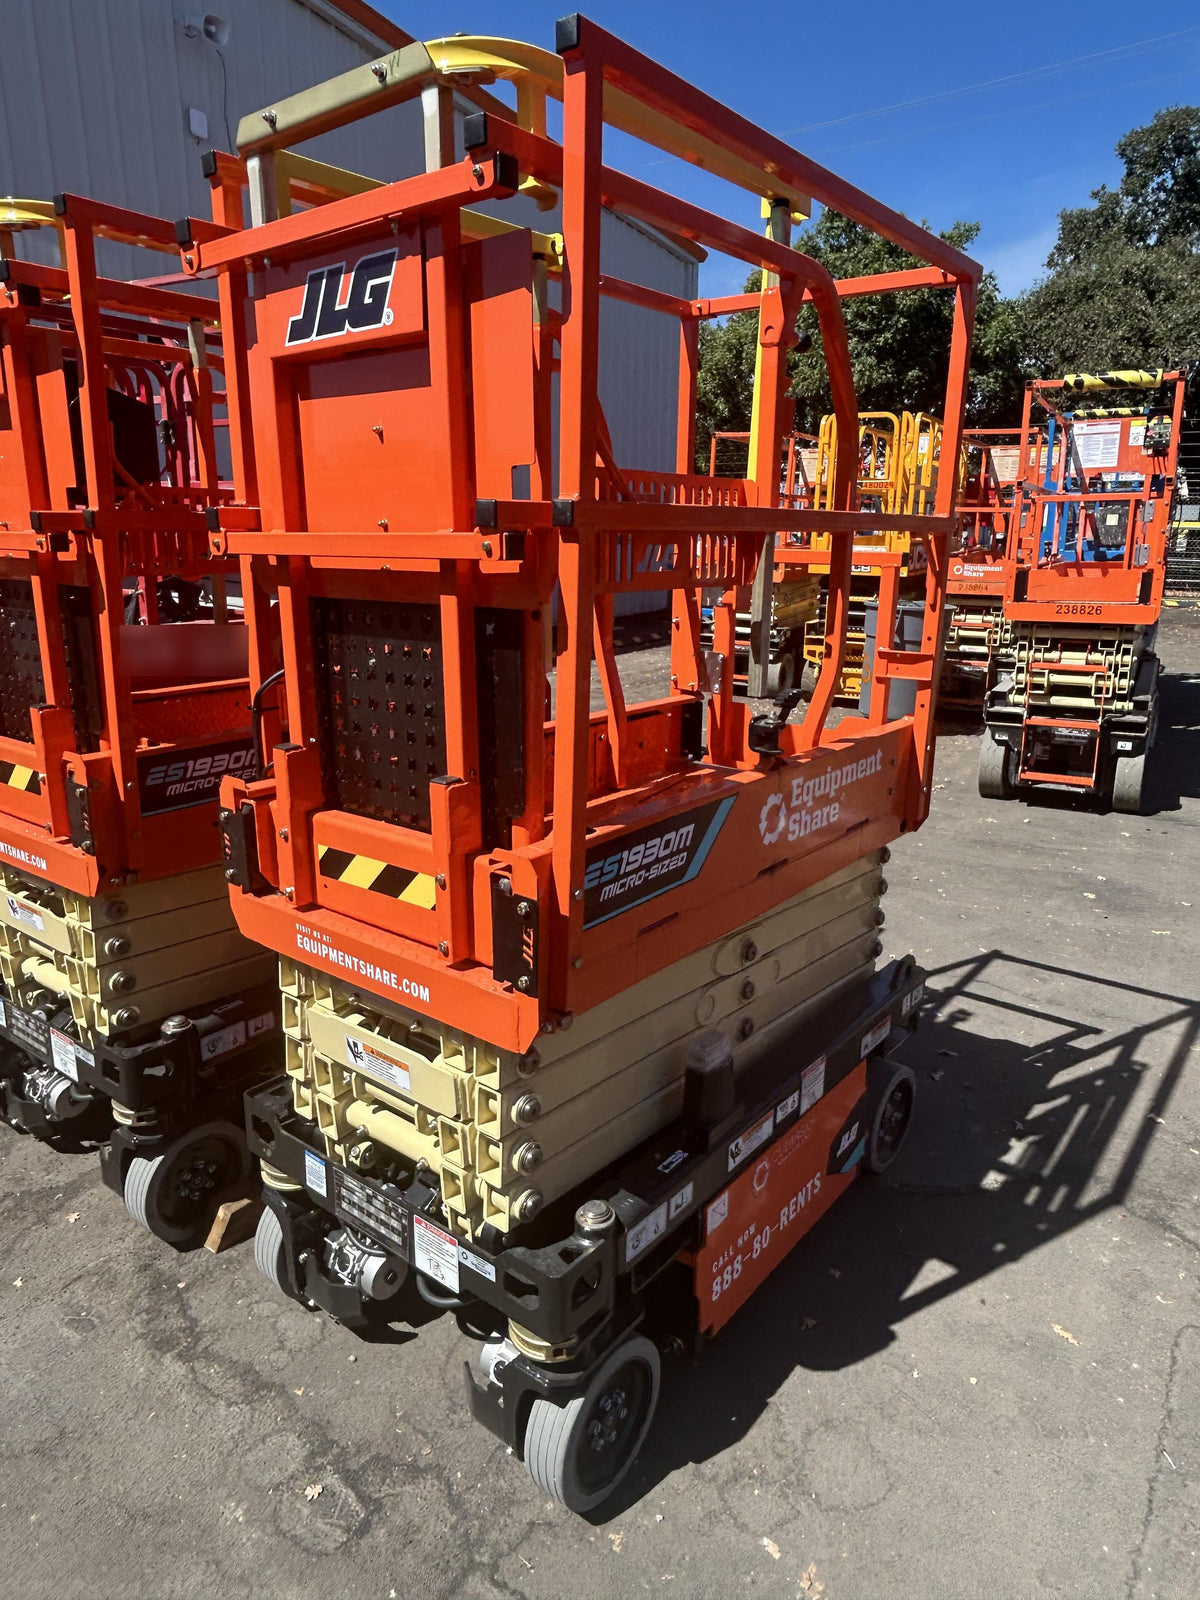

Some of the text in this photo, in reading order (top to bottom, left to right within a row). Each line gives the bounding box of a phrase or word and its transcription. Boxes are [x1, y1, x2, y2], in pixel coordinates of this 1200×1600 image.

[285, 247, 399, 347] JLG
[963, 563, 1003, 573] Equipment
[1055, 604, 1103, 616] 238826
[789, 748, 884, 808] Equipment
[787, 801, 841, 842] Share
[584, 822, 695, 890] ES1930M
[599, 851, 688, 902] MICRO-SIZED
[295, 922, 312, 934] VISIT
[313, 930, 321, 939] US
[296, 933, 431, 1003] EQUIPMENTSHARE.COM
[711, 1171, 822, 1302] 888-80-RENTS
[712, 1222, 757, 1273] CALL NOW
